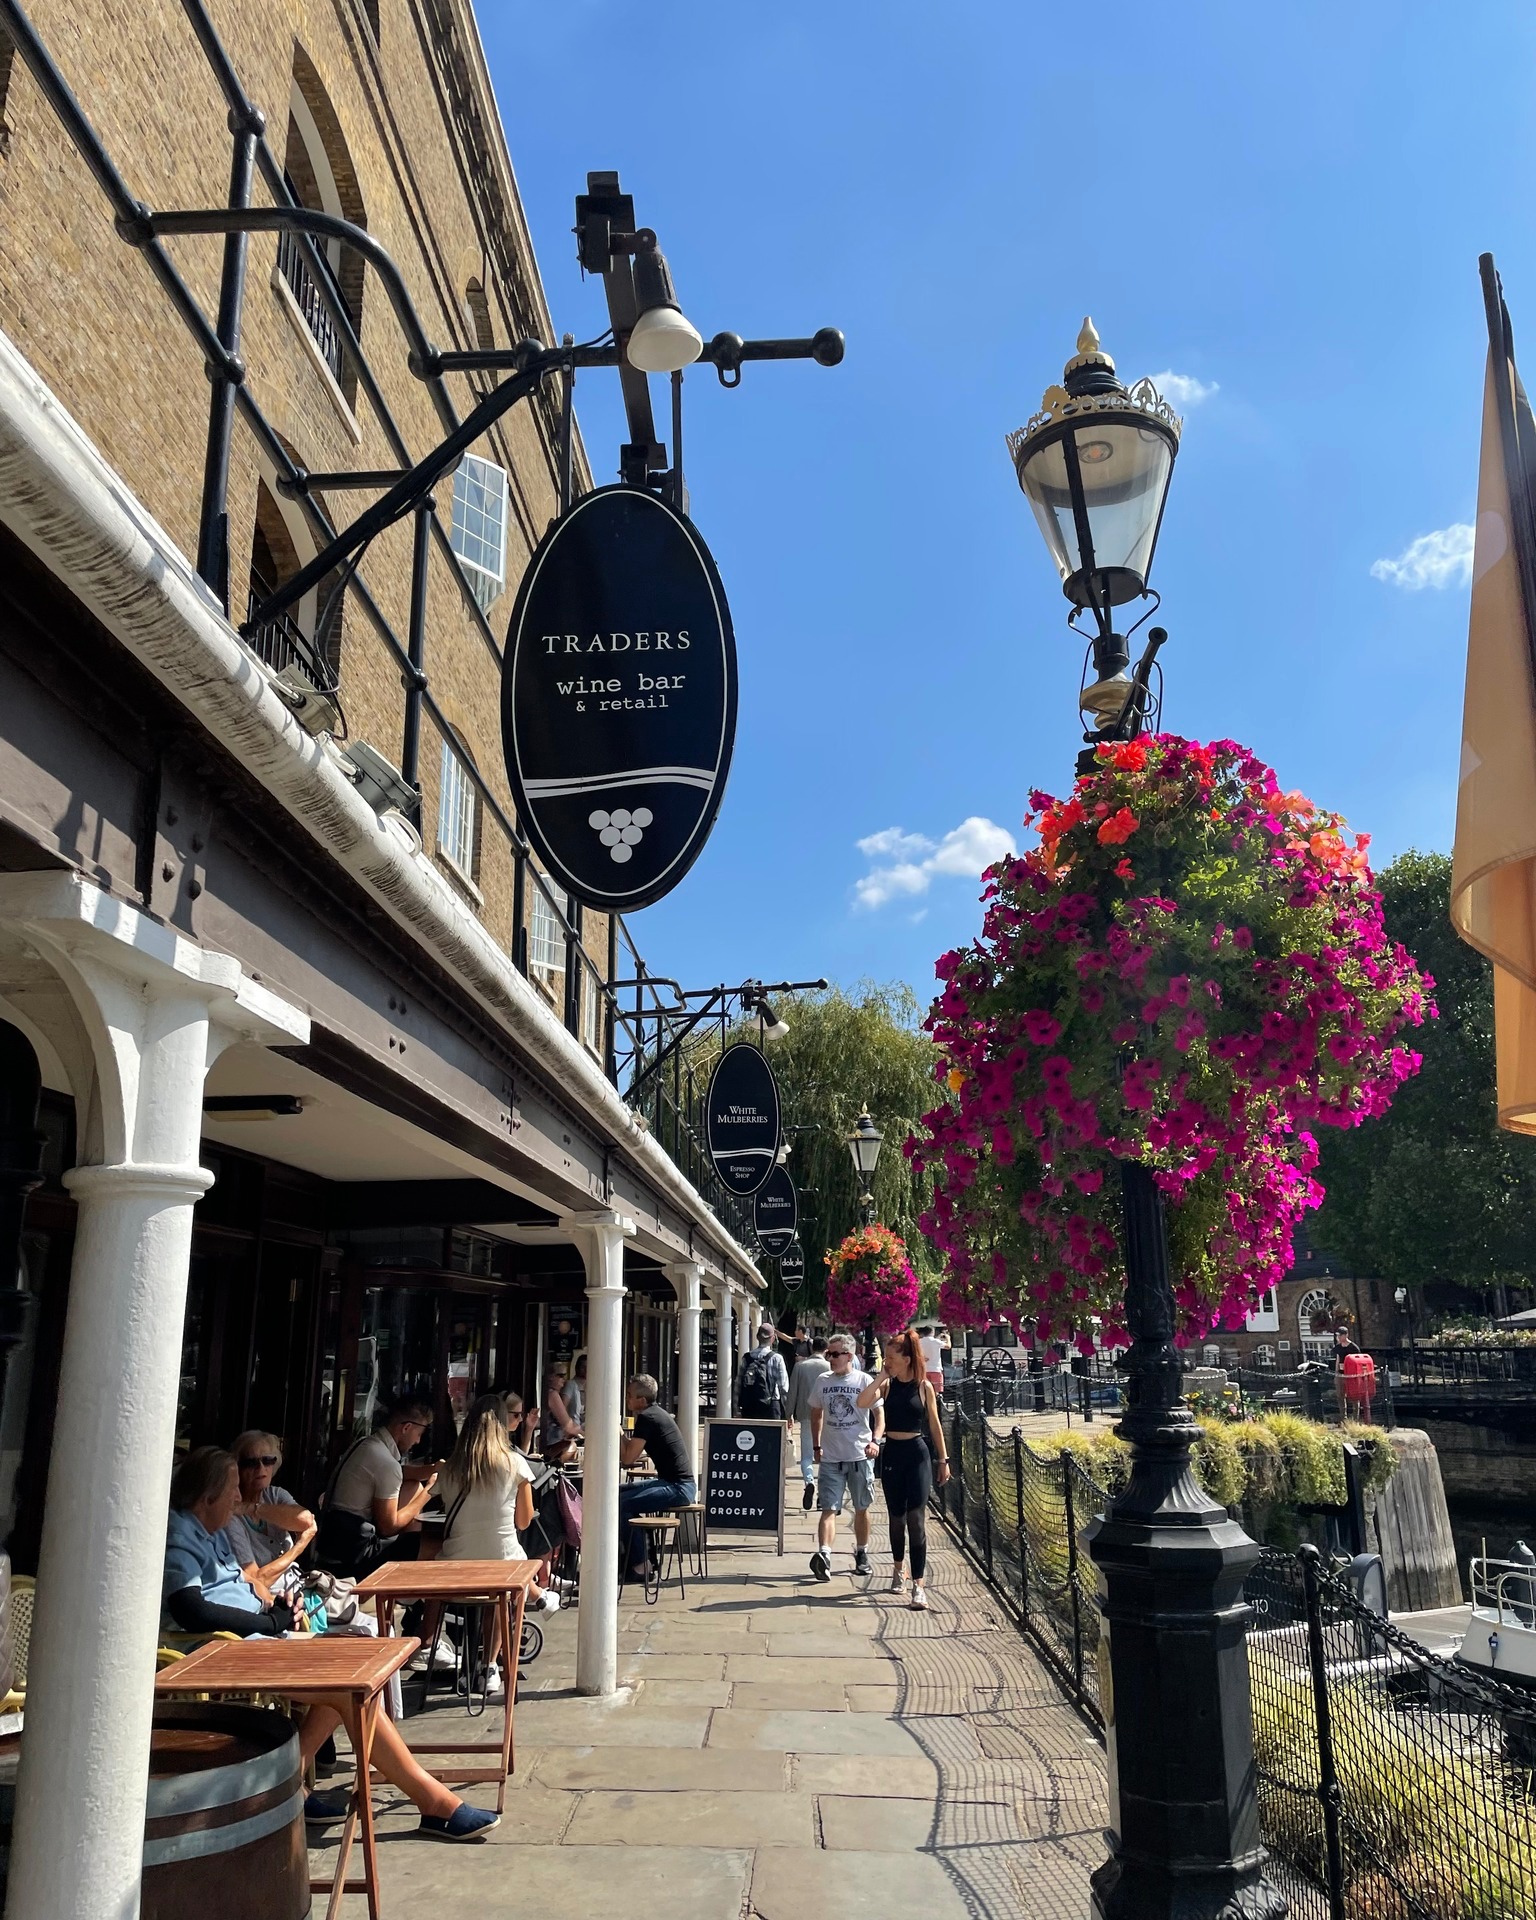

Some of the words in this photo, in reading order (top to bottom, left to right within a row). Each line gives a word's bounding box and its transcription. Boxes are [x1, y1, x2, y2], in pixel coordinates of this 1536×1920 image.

[541, 630, 691, 654] TRADERS
[556, 676, 622, 695] wine
[638, 673, 686, 691] bar
[576, 701, 586, 712] &
[599, 694, 669, 711] retail
[729, 1105, 757, 1115] WHITE
[717, 1114, 768, 1124] MULBERRIES
[822, 1385, 861, 1395] HAWKINS
[712, 1452, 759, 1462] COFFEE
[711, 1471, 749, 1480] BREAD
[710, 1489, 742, 1498] FOOD
[709, 1507, 765, 1516] GROCERY
